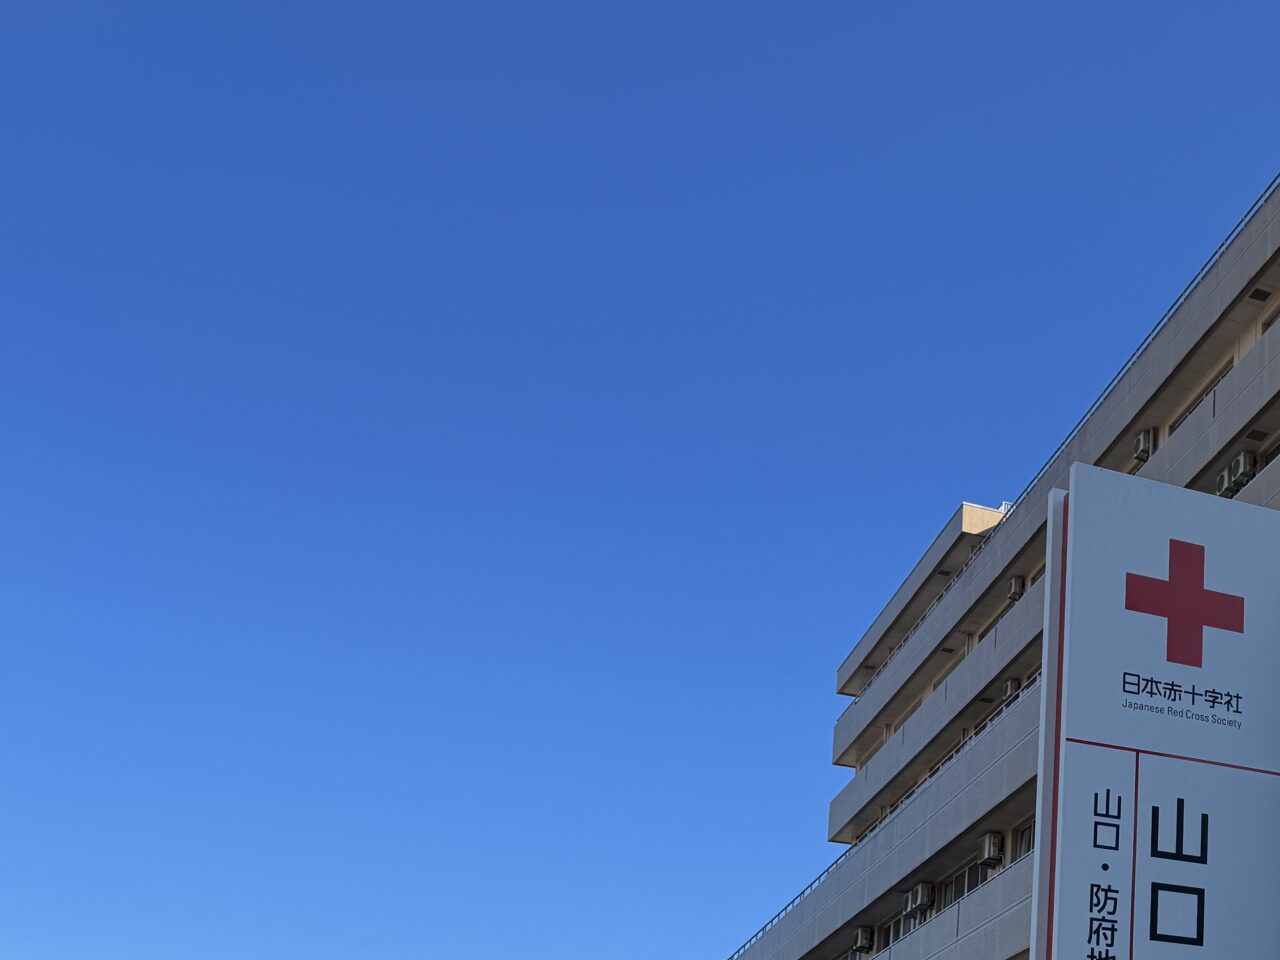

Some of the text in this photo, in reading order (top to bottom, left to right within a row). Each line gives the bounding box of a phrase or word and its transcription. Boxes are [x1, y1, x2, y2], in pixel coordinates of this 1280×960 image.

[1122, 671, 1243, 714] 日本赤十字社
[1122, 698, 1242, 730] Japanese Red Cross Society
